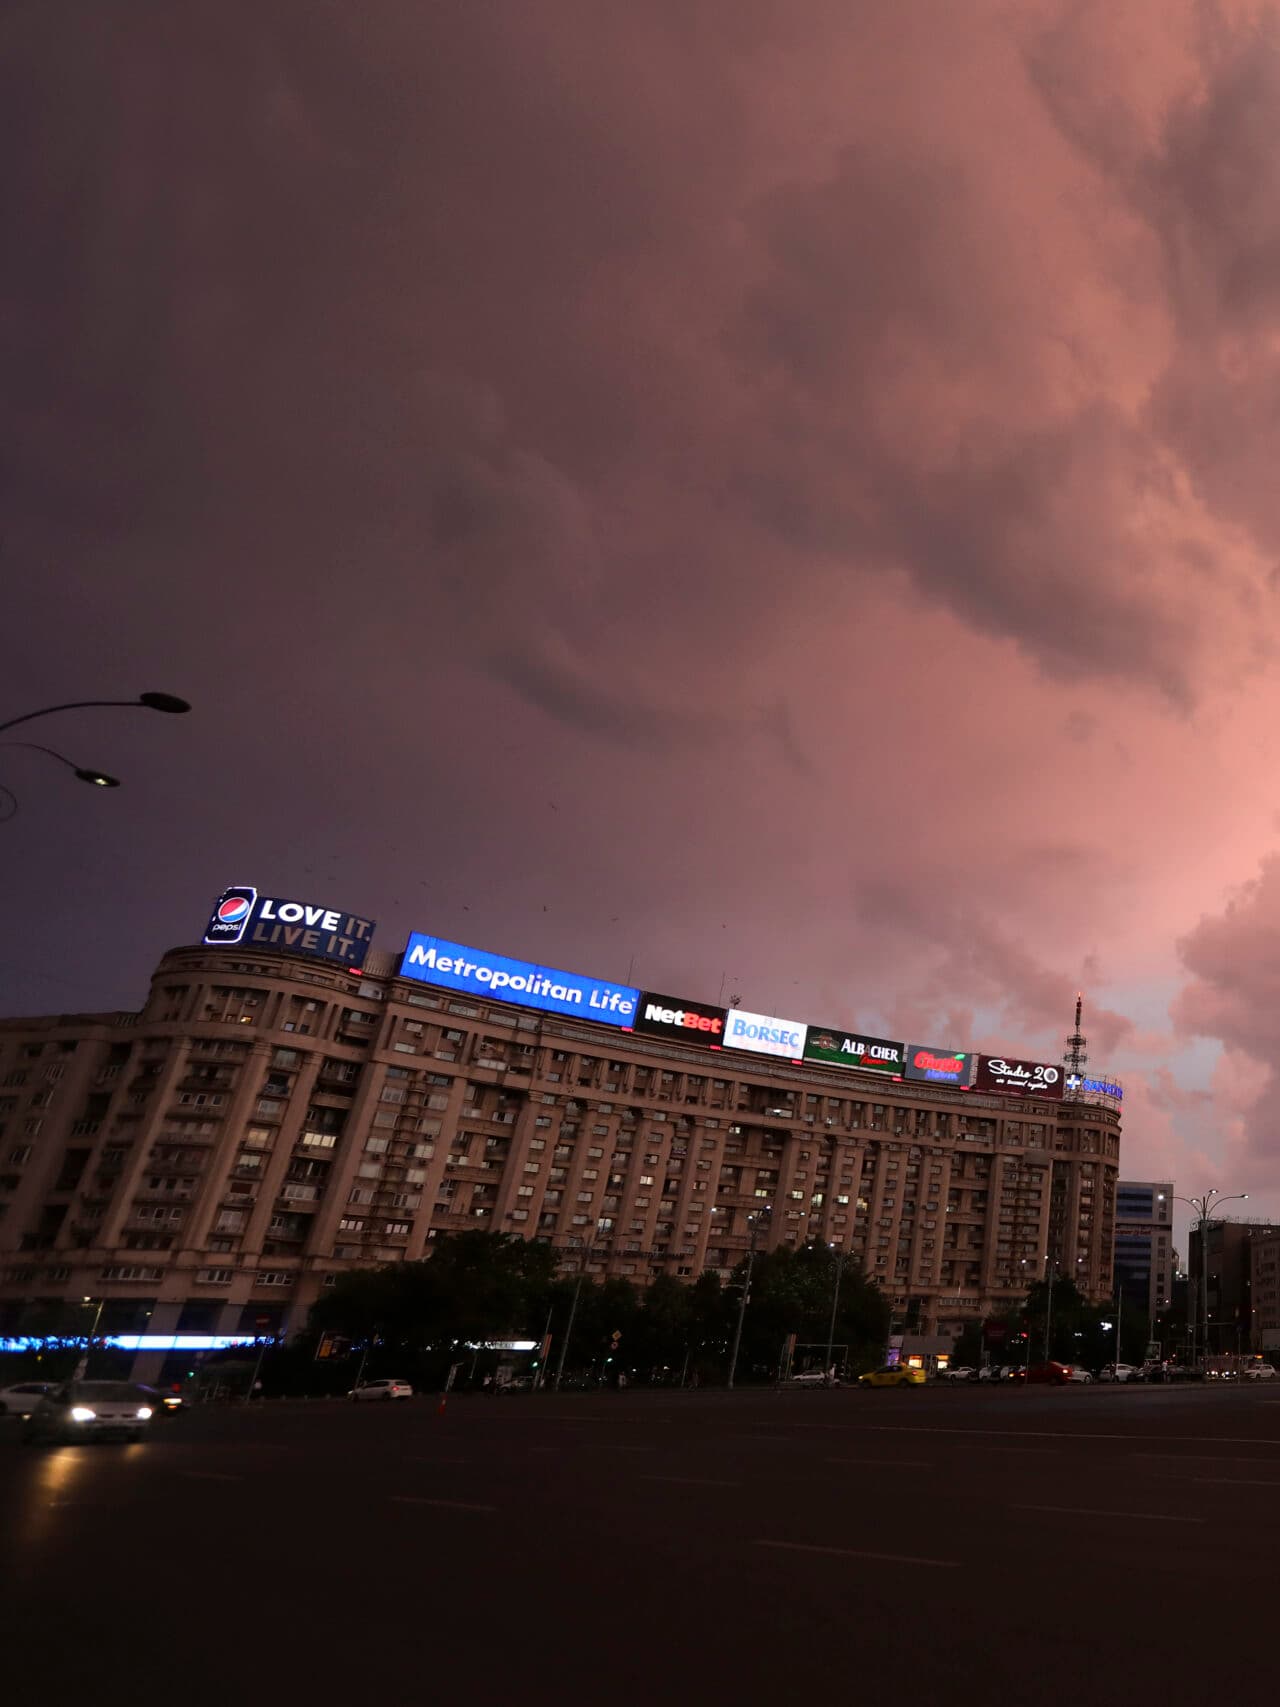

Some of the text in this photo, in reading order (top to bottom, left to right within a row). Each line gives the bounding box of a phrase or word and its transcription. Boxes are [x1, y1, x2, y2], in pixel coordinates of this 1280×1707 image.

[211, 923, 242, 933] pepsi
[259, 900, 371, 942] LOVE IT.
[252, 922, 356, 960] LIVE IT.
[409, 945, 633, 1014] Metropolitan Life
[644, 1004, 723, 1035] NetBet
[732, 1019, 799, 1047] BORSEC
[840, 1038, 899, 1063] ALBACHER
[987, 1059, 1059, 1084] Studio 20
